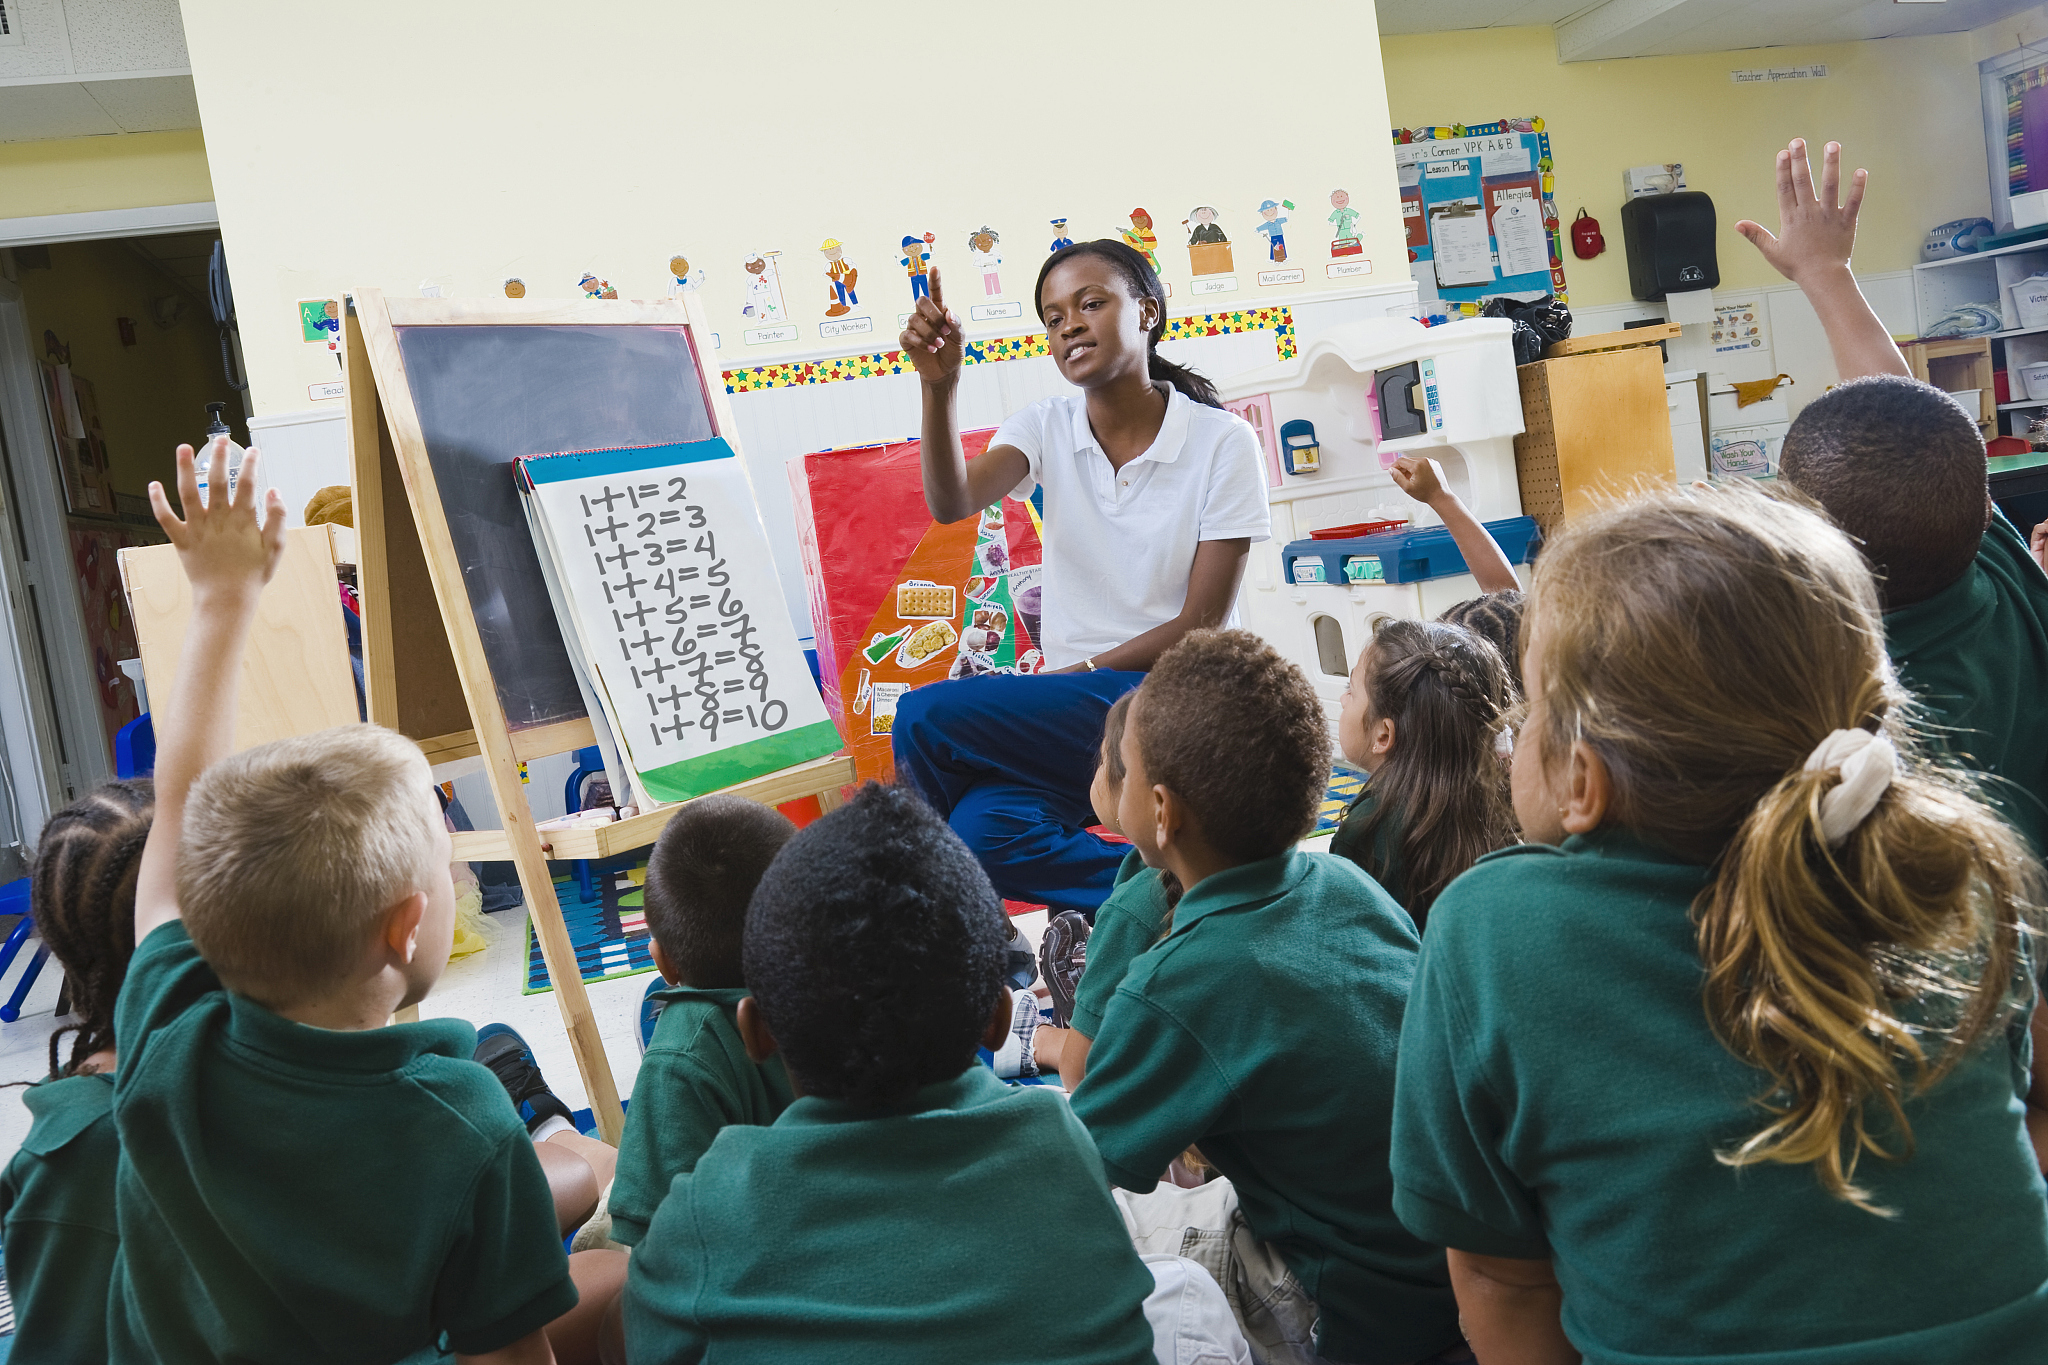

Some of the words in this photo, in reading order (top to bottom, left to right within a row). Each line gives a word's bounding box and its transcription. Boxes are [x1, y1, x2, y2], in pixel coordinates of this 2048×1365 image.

[1731, 69, 1763, 82] Teacher
[1767, 67, 1807, 82] Appreciation
[1810, 64, 1826, 77] Wall
[1431, 145, 1460, 157] Corner
[1463, 140, 1483, 153] VPK
[1497, 138, 1504, 150] &
[1425, 163, 1449, 174] Lesson
[1452, 160, 1470, 172] Plan
[1496, 190, 1532, 202] Allergies
[1402, 201, 1420, 213] orts
[1336, 265, 1362, 274] Plumber
[1262, 274, 1276, 283] Mail
[1276, 273, 1301, 282] Carrier
[1205, 282, 1225, 292] Judge
[2029, 293, 2048, 304] Victor
[986, 308, 1006, 316] Nurse
[824, 326, 840, 334] City
[841, 323, 868, 332] Worker
[757, 331, 784, 340] Painter
[1720, 449, 1738, 459] Wash
[1739, 448, 1755, 457] Your
[972, 651, 993, 666] Victoria
